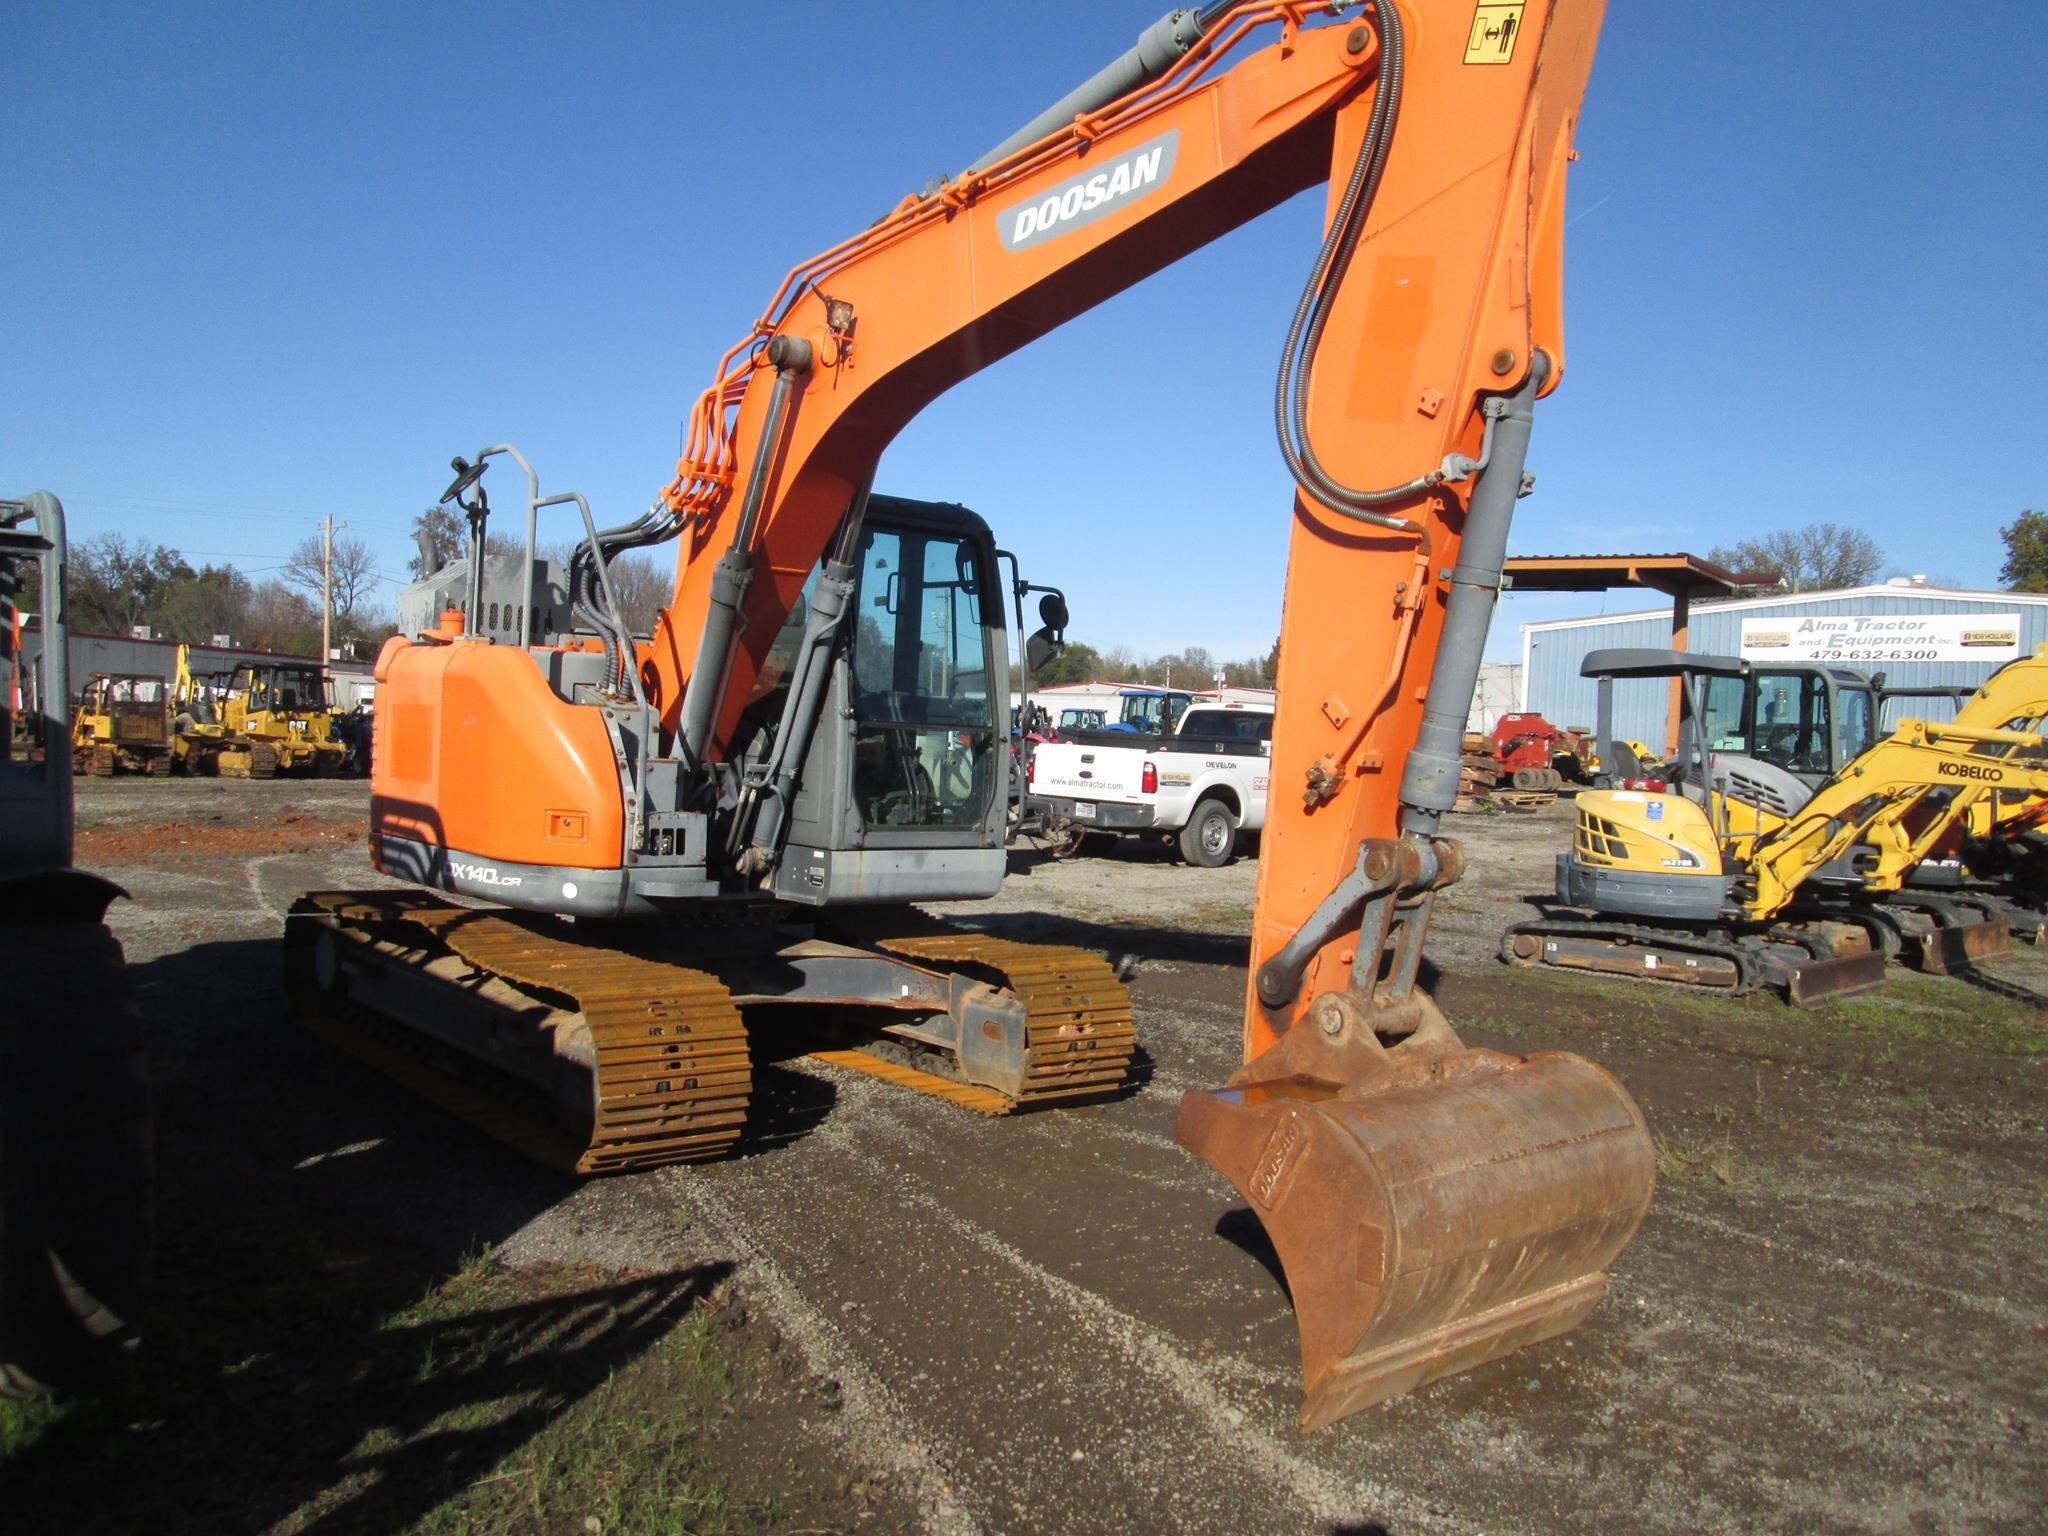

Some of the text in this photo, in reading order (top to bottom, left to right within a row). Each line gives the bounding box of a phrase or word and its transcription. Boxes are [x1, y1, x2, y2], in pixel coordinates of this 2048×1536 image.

[1012, 145, 1162, 244] DOOSAN
[1797, 617, 1928, 633] Alma Tractor
[1798, 638, 1822, 646] and
[1827, 633, 1937, 648] Equipment
[1809, 650, 1938, 660] 479-632-6300
[1206, 761, 1237, 769] DEVELON
[1938, 762, 2003, 781] KOBELCO
[1050, 778, 1123, 790] www.almatractor.com
